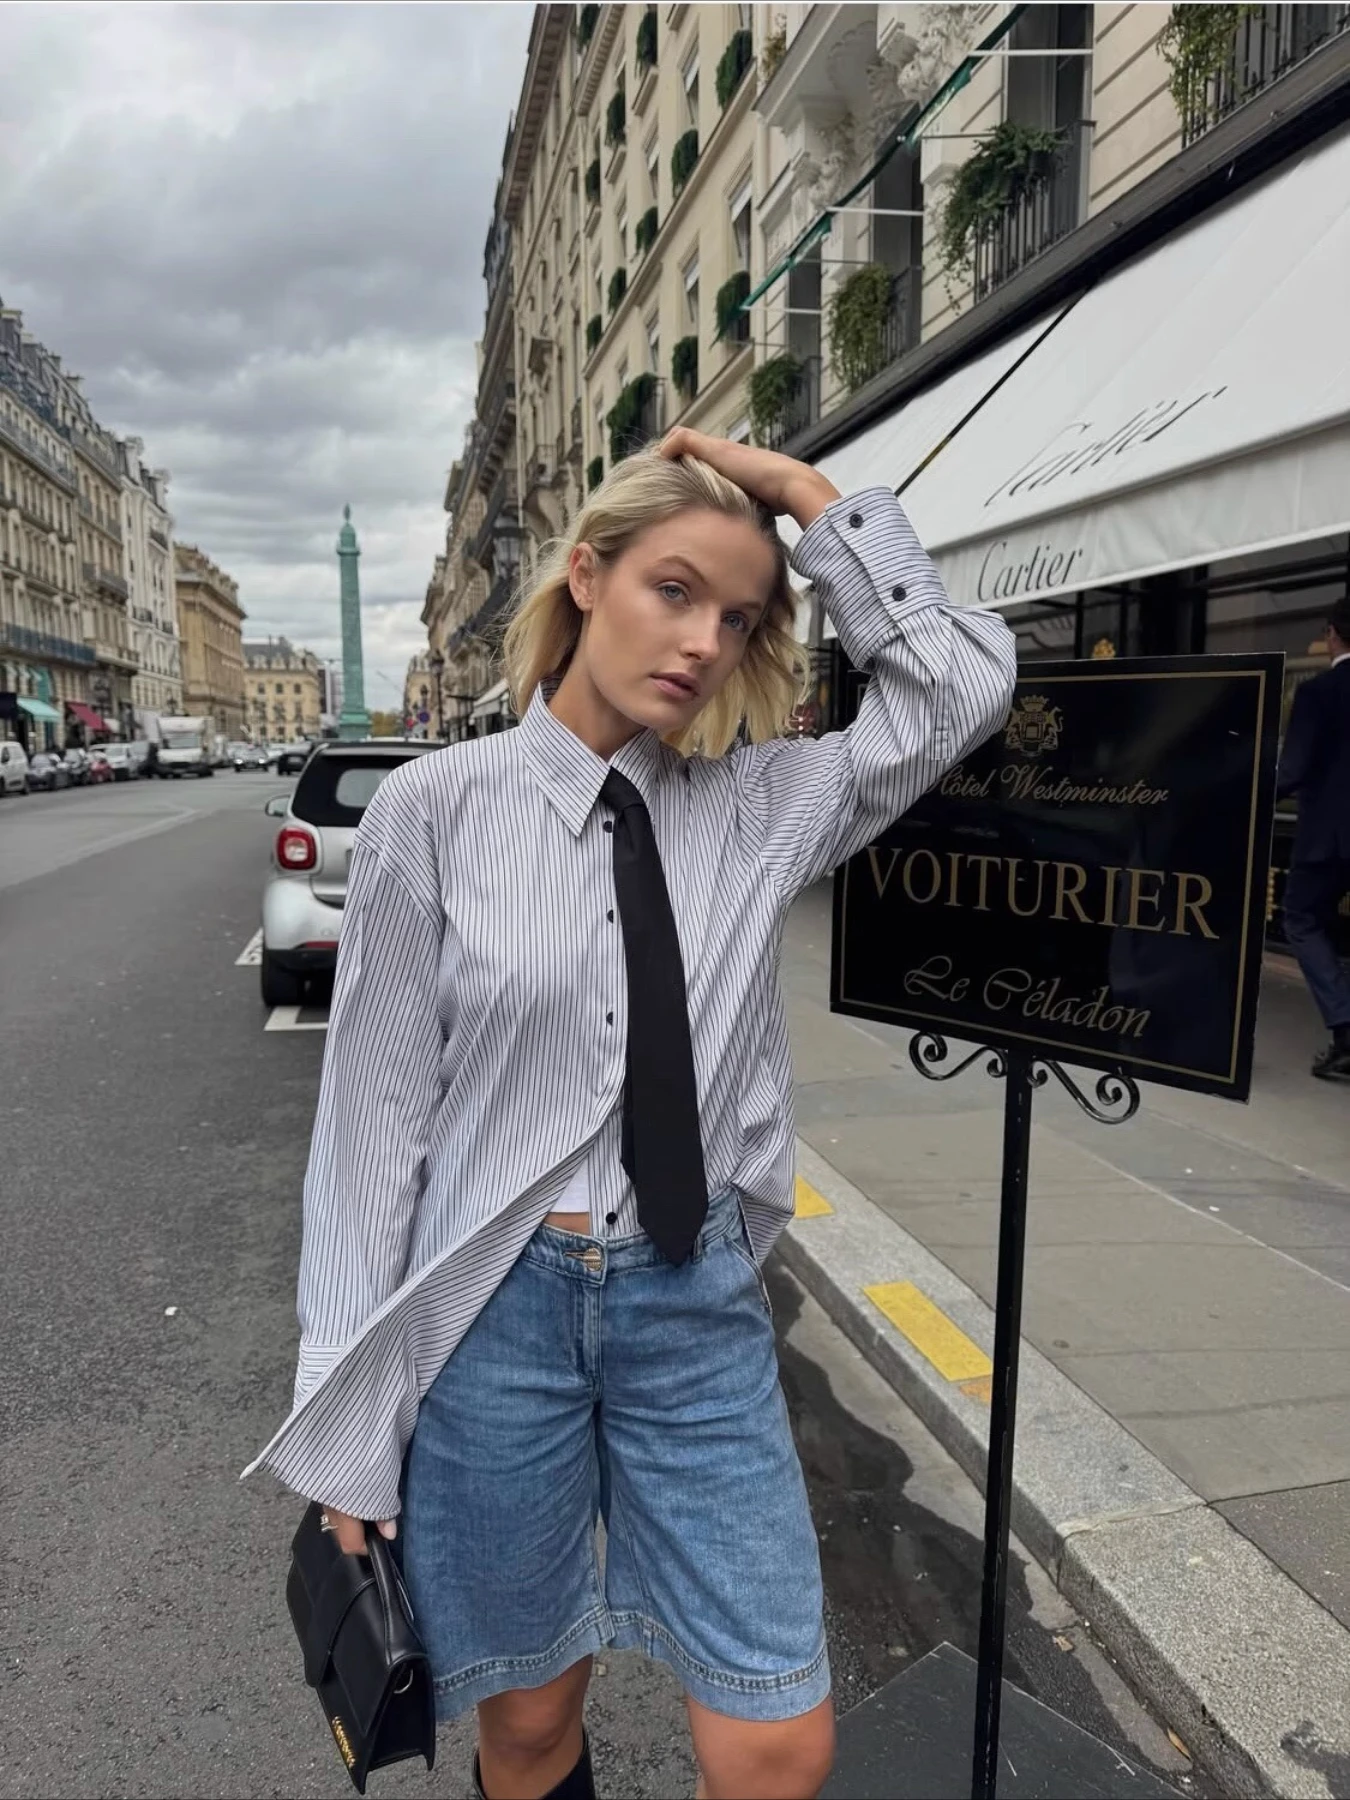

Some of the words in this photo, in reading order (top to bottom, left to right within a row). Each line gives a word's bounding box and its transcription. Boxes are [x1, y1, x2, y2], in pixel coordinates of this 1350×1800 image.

[977, 541, 1083, 602] Cartier
[1000, 761, 1170, 804] Westminster
[867, 845, 1219, 940] VOITURIER
[903, 955, 969, 1003] Le
[982, 966, 1152, 1039] Céladon
